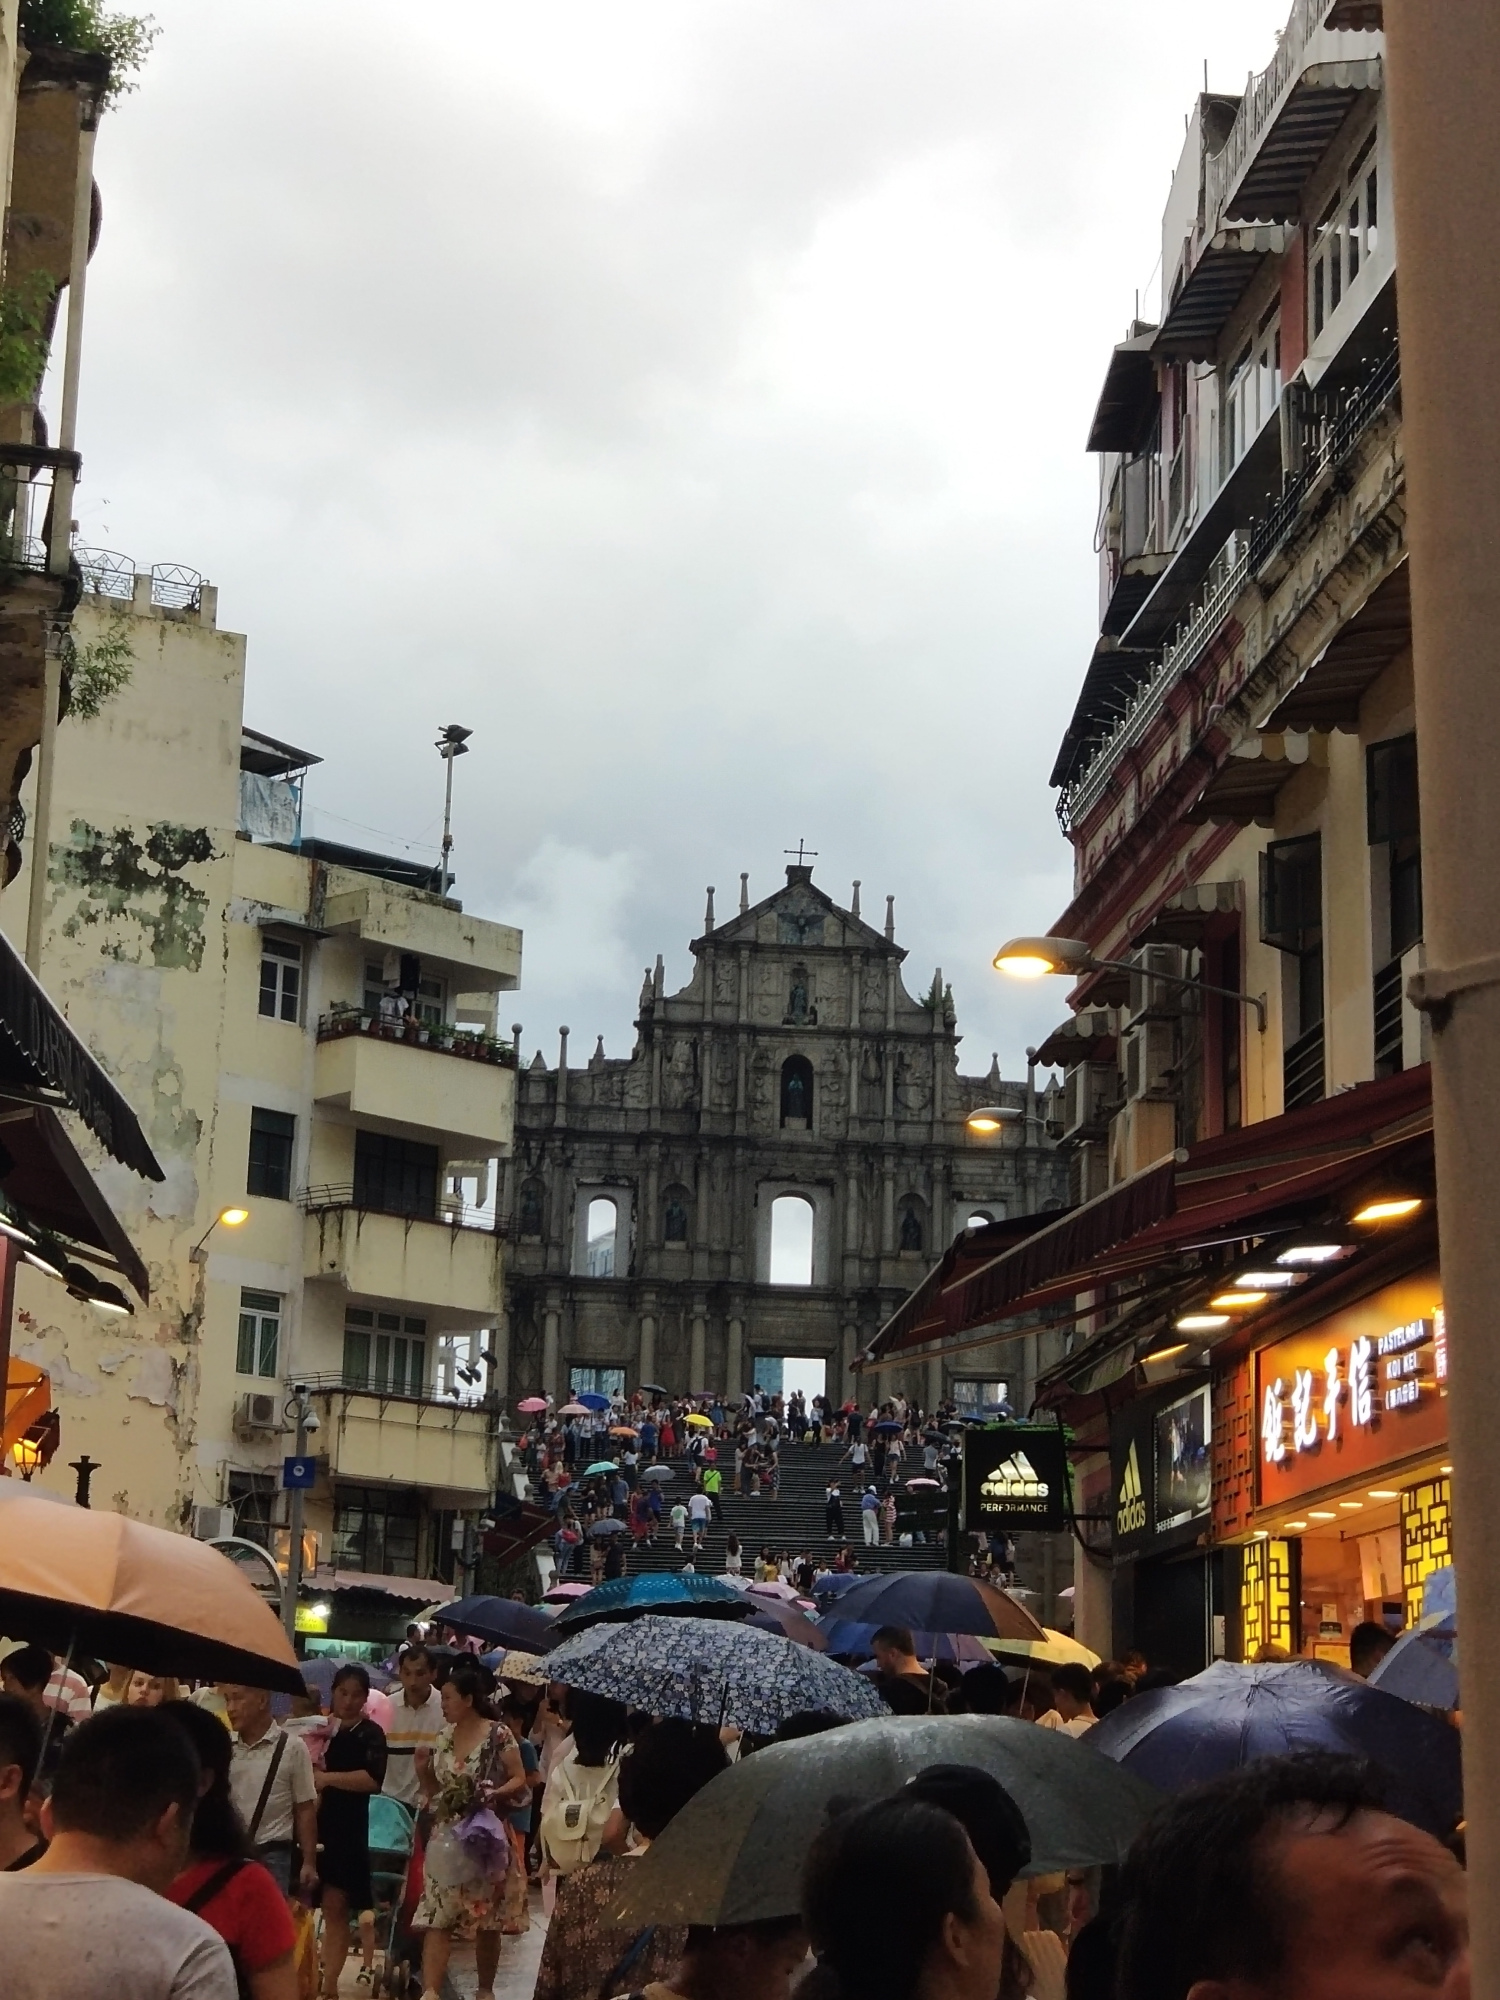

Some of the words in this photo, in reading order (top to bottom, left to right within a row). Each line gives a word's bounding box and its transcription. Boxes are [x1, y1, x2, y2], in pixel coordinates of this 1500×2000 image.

[1386, 1358, 1401, 1379] KOI
[1403, 1351, 1416, 1373] KEI
[1262, 1335, 1371, 1462] 鉅記手信
[980, 1480, 1049, 1497] adidas
[980, 1503, 1049, 1513] PERFORMANCE
[1117, 1496, 1146, 1535] adidas
